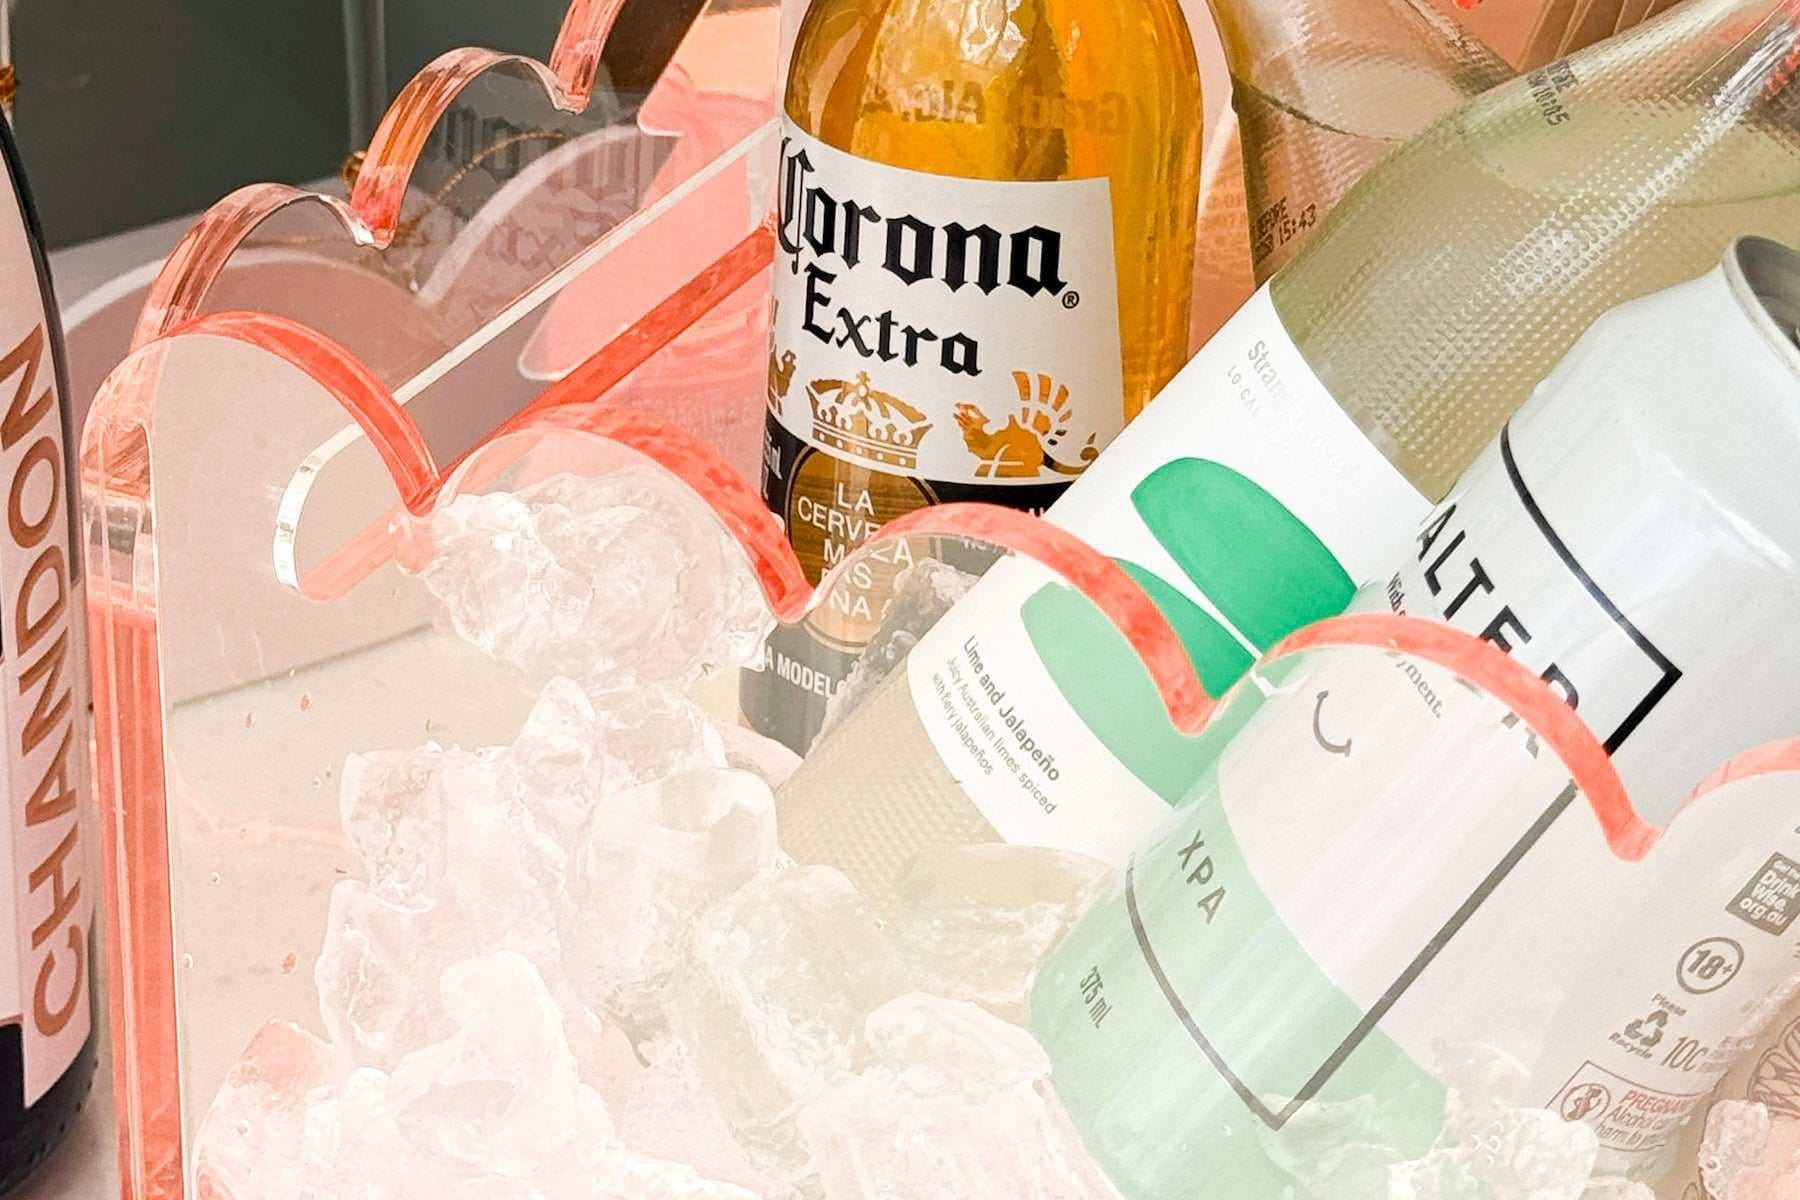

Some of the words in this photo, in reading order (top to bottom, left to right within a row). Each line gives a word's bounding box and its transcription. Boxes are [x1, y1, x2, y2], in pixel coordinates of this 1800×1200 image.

[778, 137, 1070, 298] Corona
[1278, 202, 1317, 246] 15:43
[801, 261, 983, 377] Extra
[837, 482, 875, 517] LA
[0, 321, 84, 1038] CHANDON
[963, 634, 985, 675] Lime
[979, 673, 1006, 707] and
[998, 706, 1060, 783] Jalapeño
[941, 689, 959, 722] fiery
[950, 716, 994, 776] jalapeños
[959, 682, 996, 742] Australian
[992, 735, 1022, 776] limes
[1018, 772, 1058, 815] spiced
[1176, 828, 1227, 926] XPA
[1739, 897, 1789, 927] org.au
[1651, 993, 1688, 1017] Please
[1686, 949, 1733, 981] 18+
[1608, 1032, 1653, 1060] Recycle
